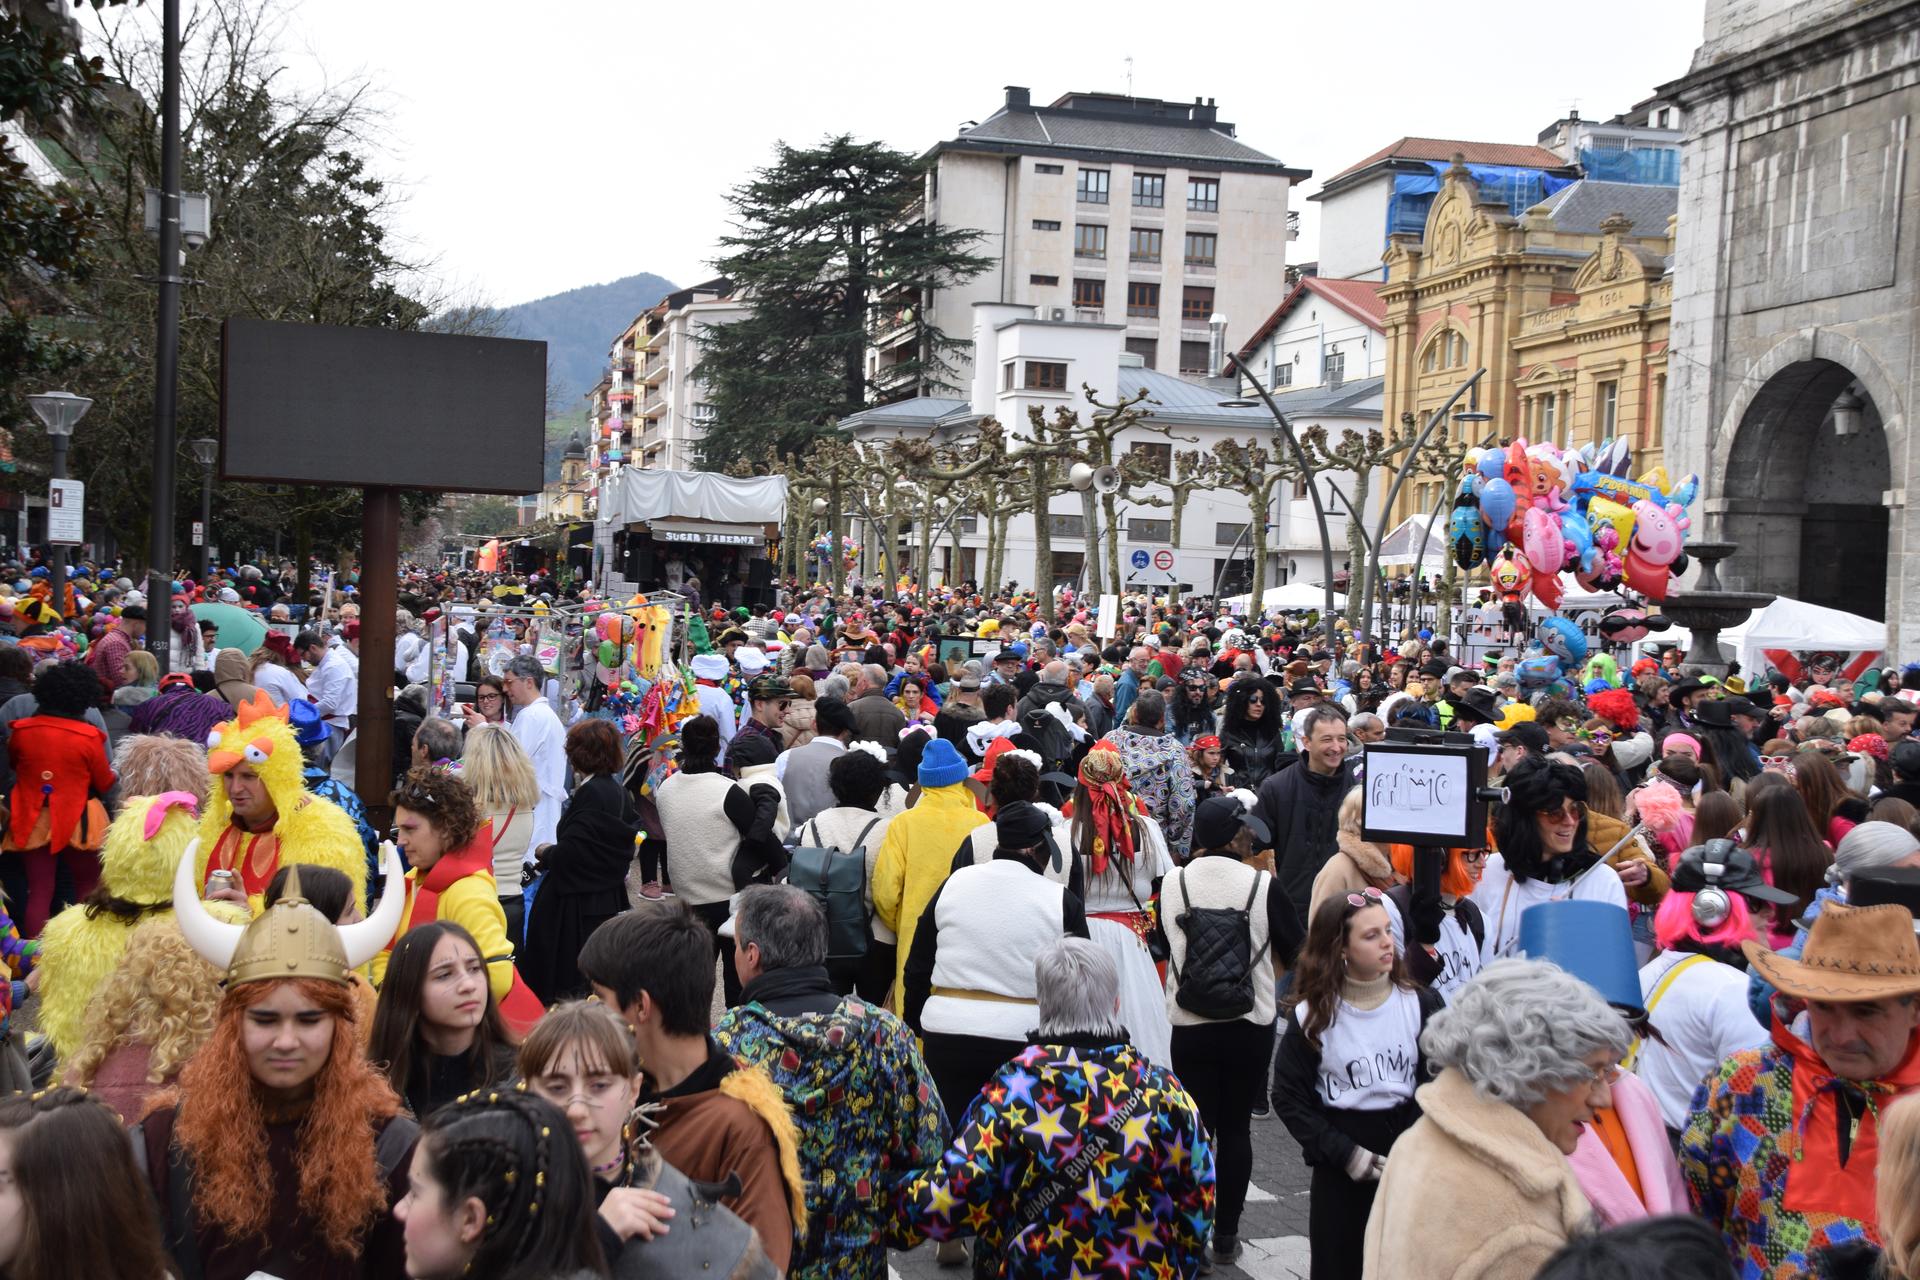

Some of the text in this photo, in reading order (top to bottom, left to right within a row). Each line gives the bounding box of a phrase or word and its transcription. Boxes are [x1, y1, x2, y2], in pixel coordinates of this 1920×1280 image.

[665, 532, 755, 545] SUGAR TABERNA
[1023, 1180, 1065, 1221] BIMBA
[1064, 1136, 1109, 1180] BIMBA
[1107, 1087, 1144, 1133] BIMBA
